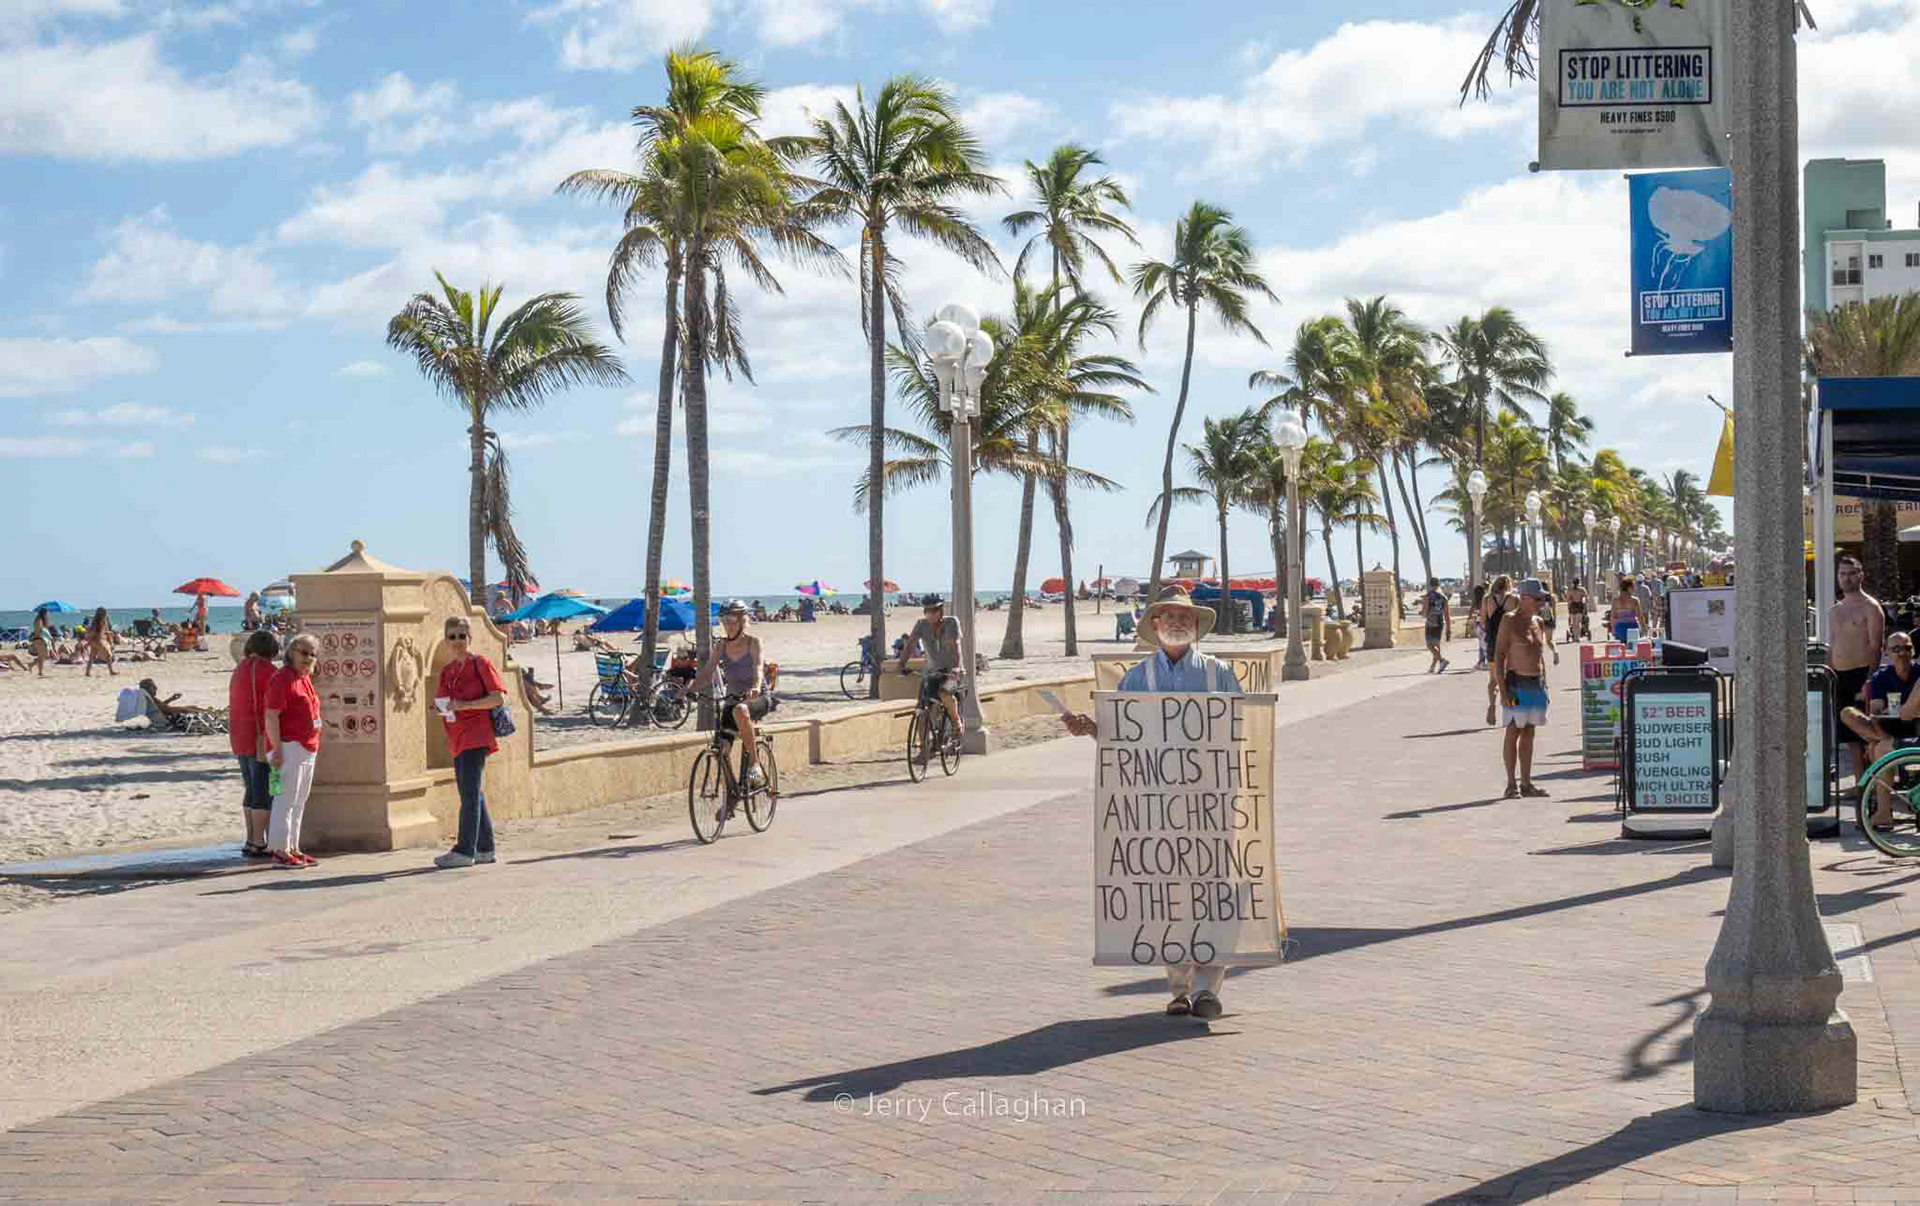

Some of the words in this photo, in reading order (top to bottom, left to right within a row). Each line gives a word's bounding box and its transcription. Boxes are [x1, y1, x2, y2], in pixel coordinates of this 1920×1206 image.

[1567, 55, 1610, 80] STOP
[1616, 54, 1703, 79] LITTERING
[1568, 80, 1594, 100] YOU
[1600, 80, 1625, 100] ARE
[1630, 79, 1654, 99] NOT
[1662, 79, 1703, 99] ALONE
[1600, 111, 1627, 124] HEAVY
[1630, 111, 1653, 123] FINES
[1644, 295, 1669, 308] STOP
[1671, 292, 1720, 308] LITTERING
[1645, 308, 1660, 320] YOU
[1107, 698, 1144, 743] IS
[1161, 696, 1248, 743] POPE
[1665, 706, 1706, 719] BEER
[1635, 722, 1711, 734] BUDWEISER
[1635, 738, 1661, 748] BUD
[1665, 737, 1703, 748] LIGHT
[1635, 752, 1670, 763] BUSH
[1099, 747, 1202, 789] FRANCIS
[1206, 749, 1260, 790] THE
[1635, 766, 1711, 778] YUENGLING
[1635, 781, 1667, 792] MICH
[1671, 780, 1712, 792] ULTRA
[1643, 794, 1657, 805] $3
[1665, 793, 1709, 804] SHOTS
[1102, 793, 1267, 832] ANTICHRIST
[1109, 836, 1264, 879] ACCORDING
[1097, 883, 1128, 922] TO
[1132, 881, 1183, 922] THE
[1190, 881, 1268, 922] BIBLE
[1131, 923, 1216, 965] 666
